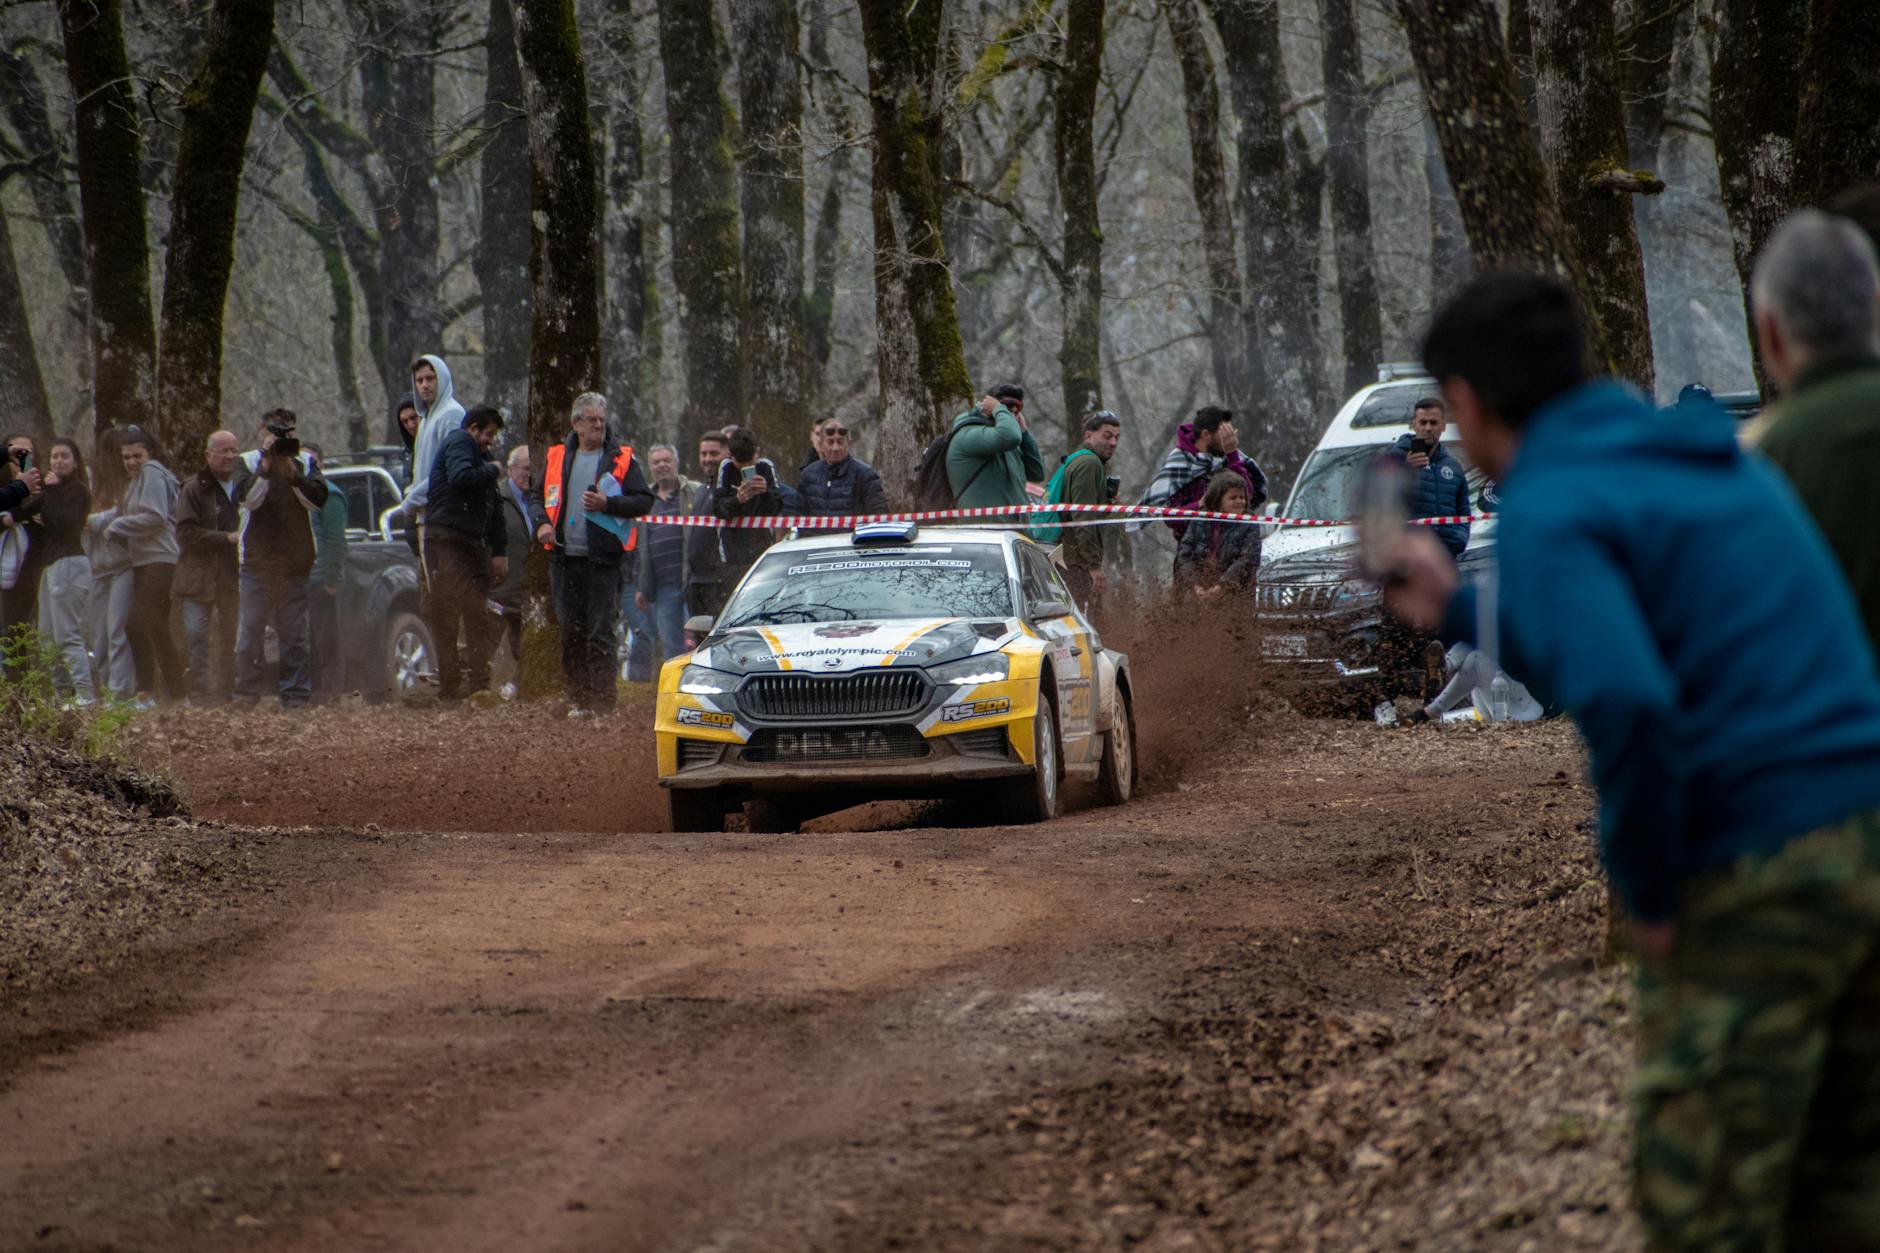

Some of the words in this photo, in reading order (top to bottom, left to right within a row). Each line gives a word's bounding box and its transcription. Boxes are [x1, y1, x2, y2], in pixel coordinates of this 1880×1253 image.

[757, 647, 916, 663] www.royalolympic.com
[677, 708, 734, 725] RS200
[942, 699, 1009, 721] RS200
[776, 730, 890, 756] DELTA
